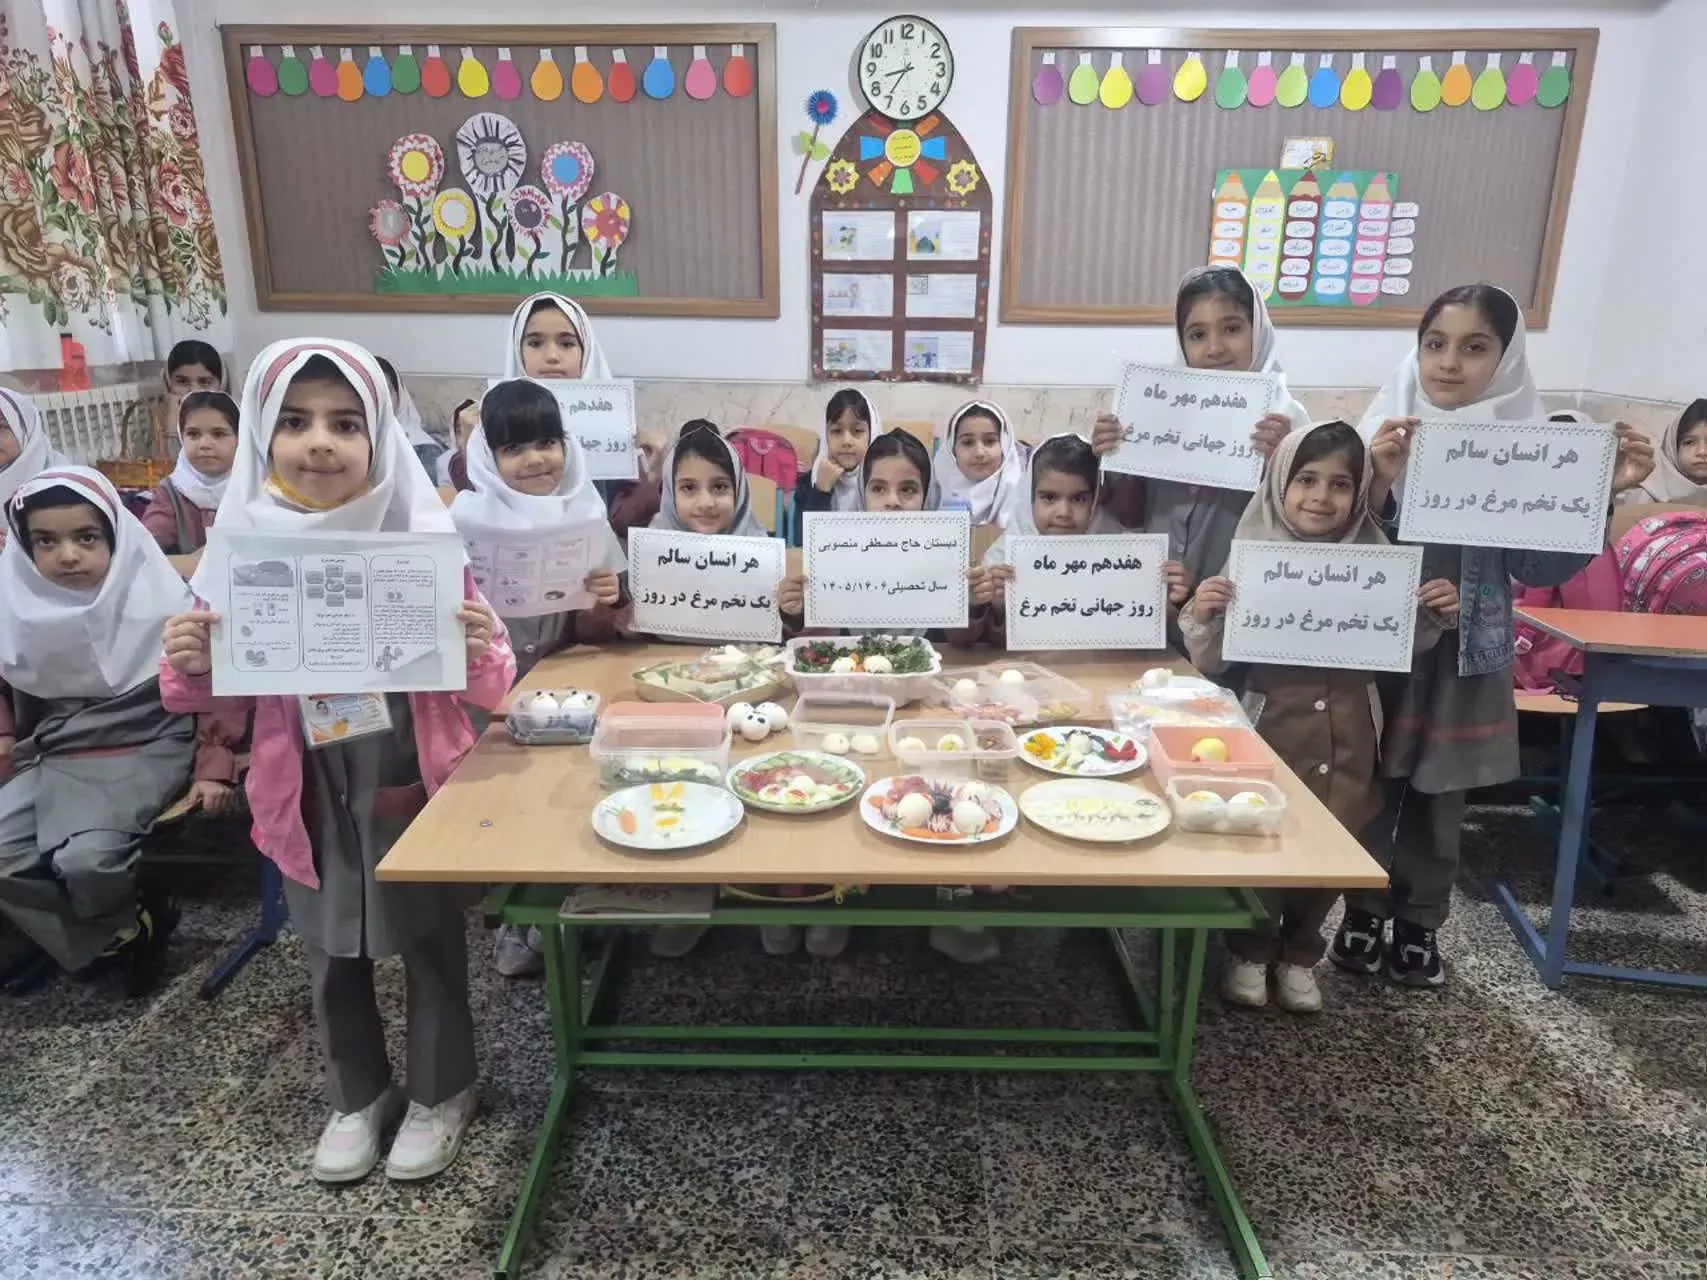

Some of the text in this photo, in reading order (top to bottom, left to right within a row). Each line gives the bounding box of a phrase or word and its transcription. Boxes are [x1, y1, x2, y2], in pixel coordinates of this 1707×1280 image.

[884, 29, 893, 44] 11
[901, 23, 914, 39] 12
[871, 43, 883, 58] 10
[930, 42, 941, 59] 2
[866, 62, 877, 77] 9
[936, 62, 946, 78] 3
[871, 81, 881, 96] 8
[930, 81, 941, 96] 4
[883, 95, 893, 110] 7
[900, 100, 910, 115] 6
[917, 95, 927, 110] 5
[1144, 383, 1247, 410] هفدهم مهر ماه
[569, 397, 613, 415] هفدهم
[579, 435, 627, 452] روز جها
[1123, 422, 1253, 458] روز جهانی تخم مرغ
[1445, 439, 1579, 469] هر انسان سالم
[1419, 489, 1590, 518] یک تخم مرغ در روز
[861, 537, 898, 552] مصطفی
[901, 537, 921, 552] حاج
[923, 538, 957, 551] دبستان
[657, 547, 760, 573] هر انسان سالم
[1033, 554, 1142, 575] هفدهم مهر ماه
[1263, 560, 1386, 589] هر انسان سالم
[887, 581, 926, 595] تحصیلی
[928, 580, 948, 592] سال
[641, 588, 771, 612] یک تخم مرغ در روز
[1019, 596, 1153, 617] روز جهانی تخم مرغ
[1241, 609, 1400, 636] یک تخم مرغ در روز
